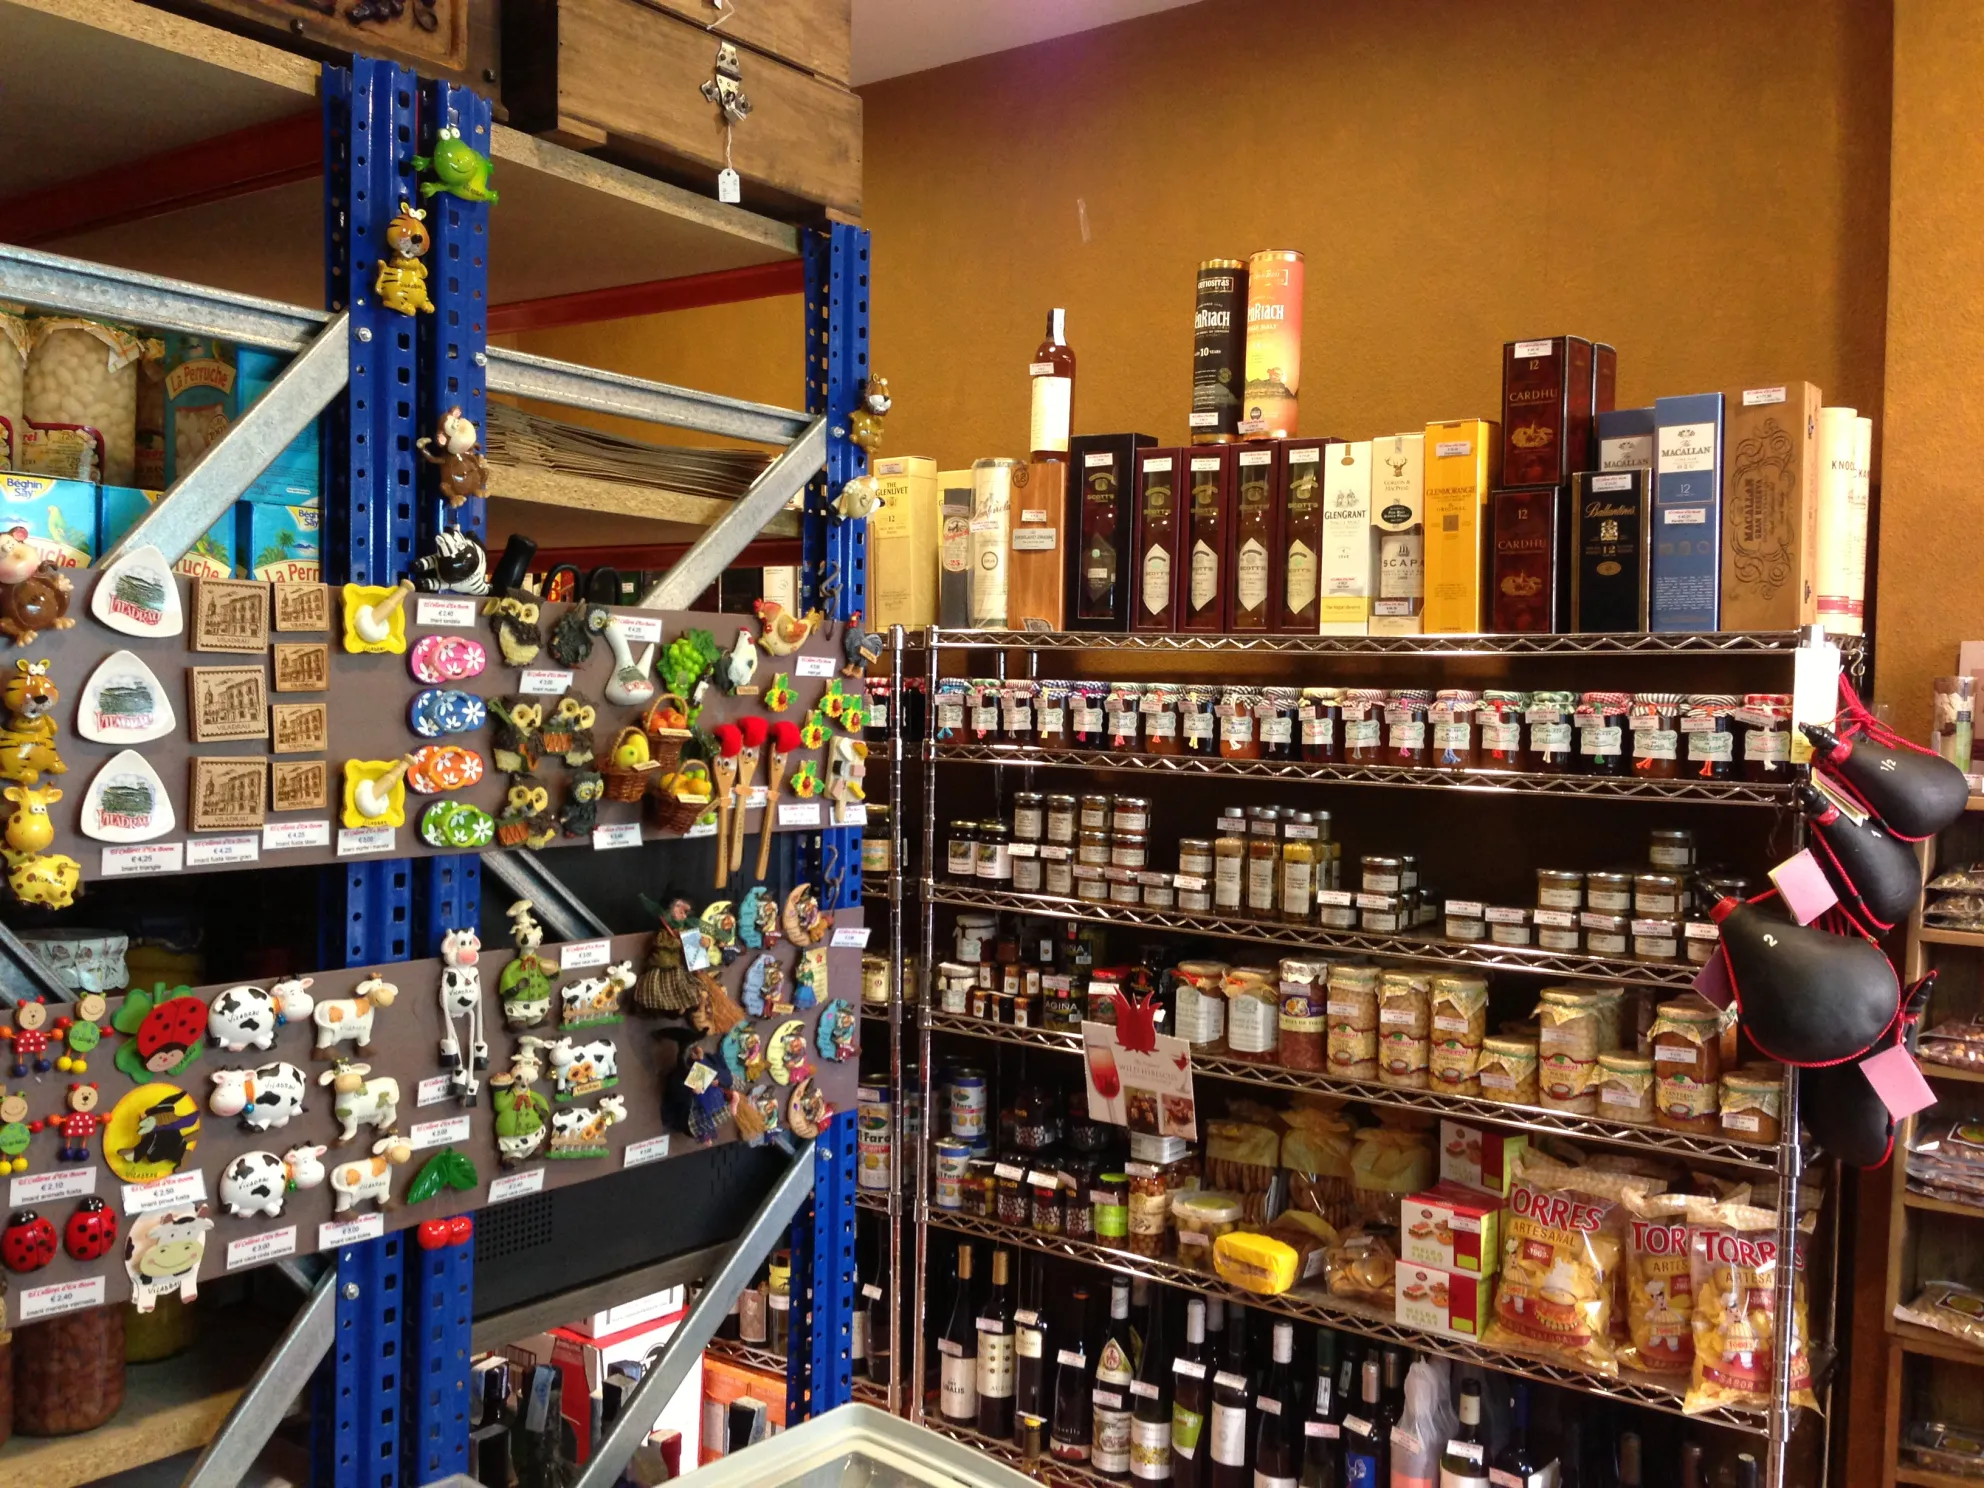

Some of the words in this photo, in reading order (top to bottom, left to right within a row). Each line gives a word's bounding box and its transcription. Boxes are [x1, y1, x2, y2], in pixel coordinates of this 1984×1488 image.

[1200, 347, 1209, 357] 10
[1529, 359, 1539, 370] 12
[170, 373, 182, 392] La
[184, 366, 228, 388] Perruche
[1509, 388, 1557, 401] CARDHU
[1661, 446, 1711, 457] MACALLAN
[1604, 457, 1649, 469] MACALLAN
[7, 478, 42, 490] Béghin
[1680, 483, 1691, 493] 12
[14, 487, 34, 498] Say
[875, 487, 908, 497] GLENLIVET
[1426, 486, 1476, 496] GLENMORANGIE
[1518, 509, 1528, 519] 12
[1498, 538, 1547, 549] CARDHU
[1602, 545, 1616, 554] 12
[1763, 934, 1778, 947] 2
[1514, 1221, 1575, 1247] ARTESANAL
[1406, 1307, 1438, 1319] MELBA
[1405, 1313, 1439, 1327] TOAST
[1719, 1373, 1753, 1389] SABOR
